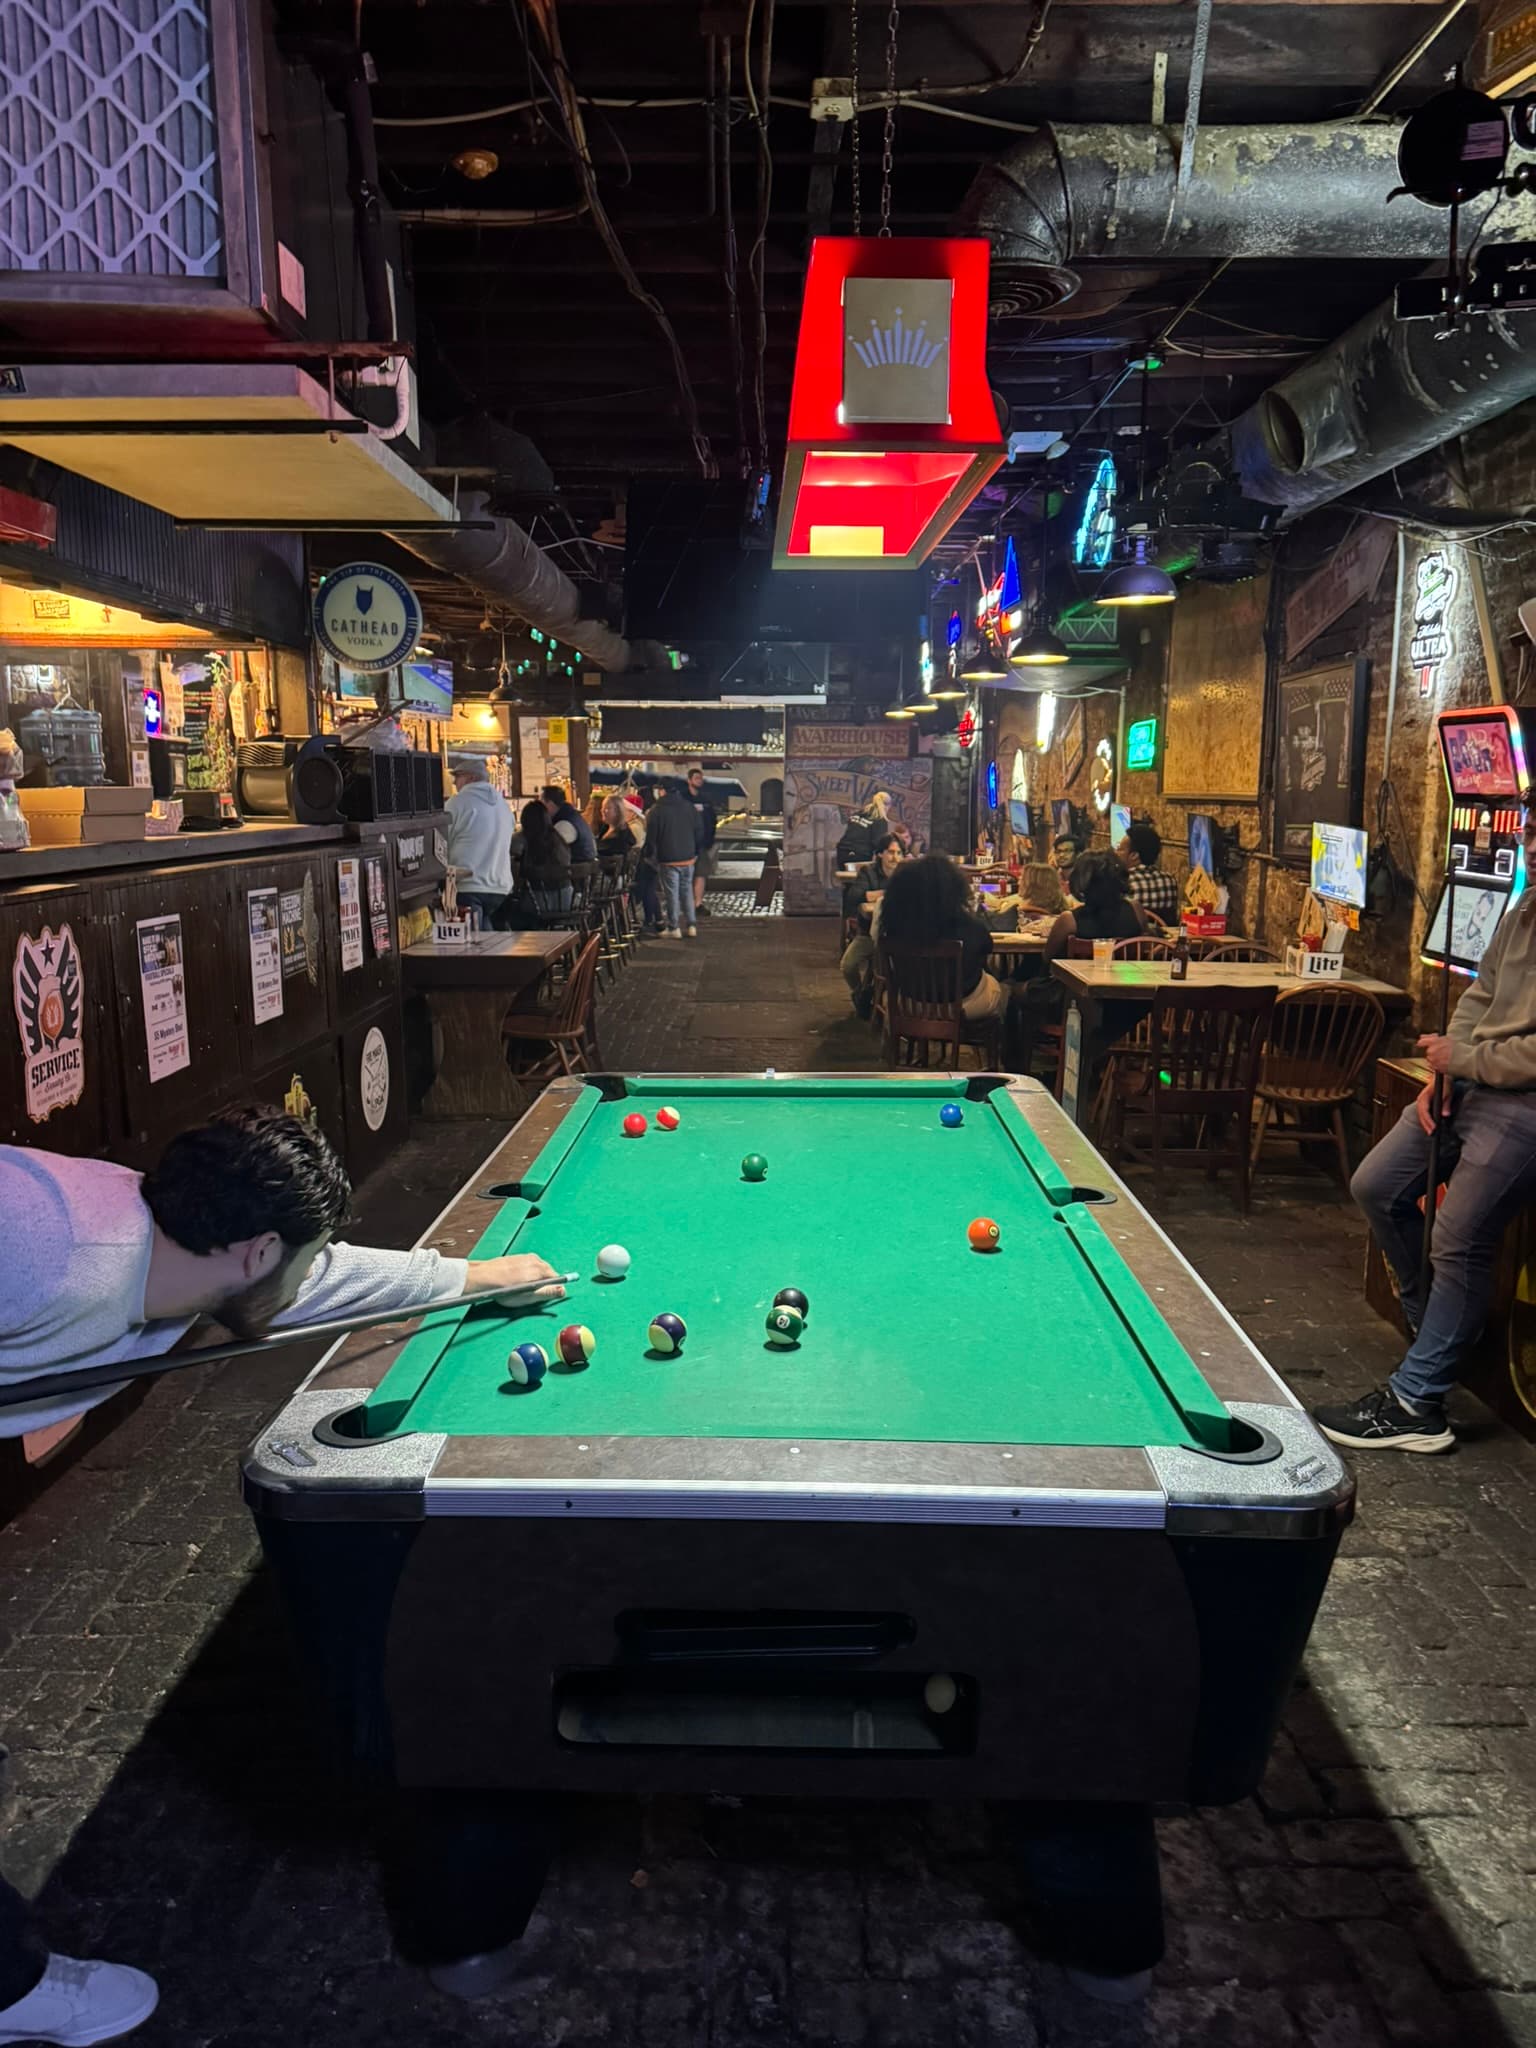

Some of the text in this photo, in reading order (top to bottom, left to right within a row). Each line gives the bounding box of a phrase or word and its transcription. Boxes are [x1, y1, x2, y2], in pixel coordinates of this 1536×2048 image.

[331, 618, 399, 637] CATHEAD
[347, 636, 383, 647] VODKA
[1411, 637, 1447, 660] ULTRA
[437, 925, 461, 940] Lite
[1309, 956, 1339, 974] Lite
[31, 1047, 81, 1089] SERVICE
